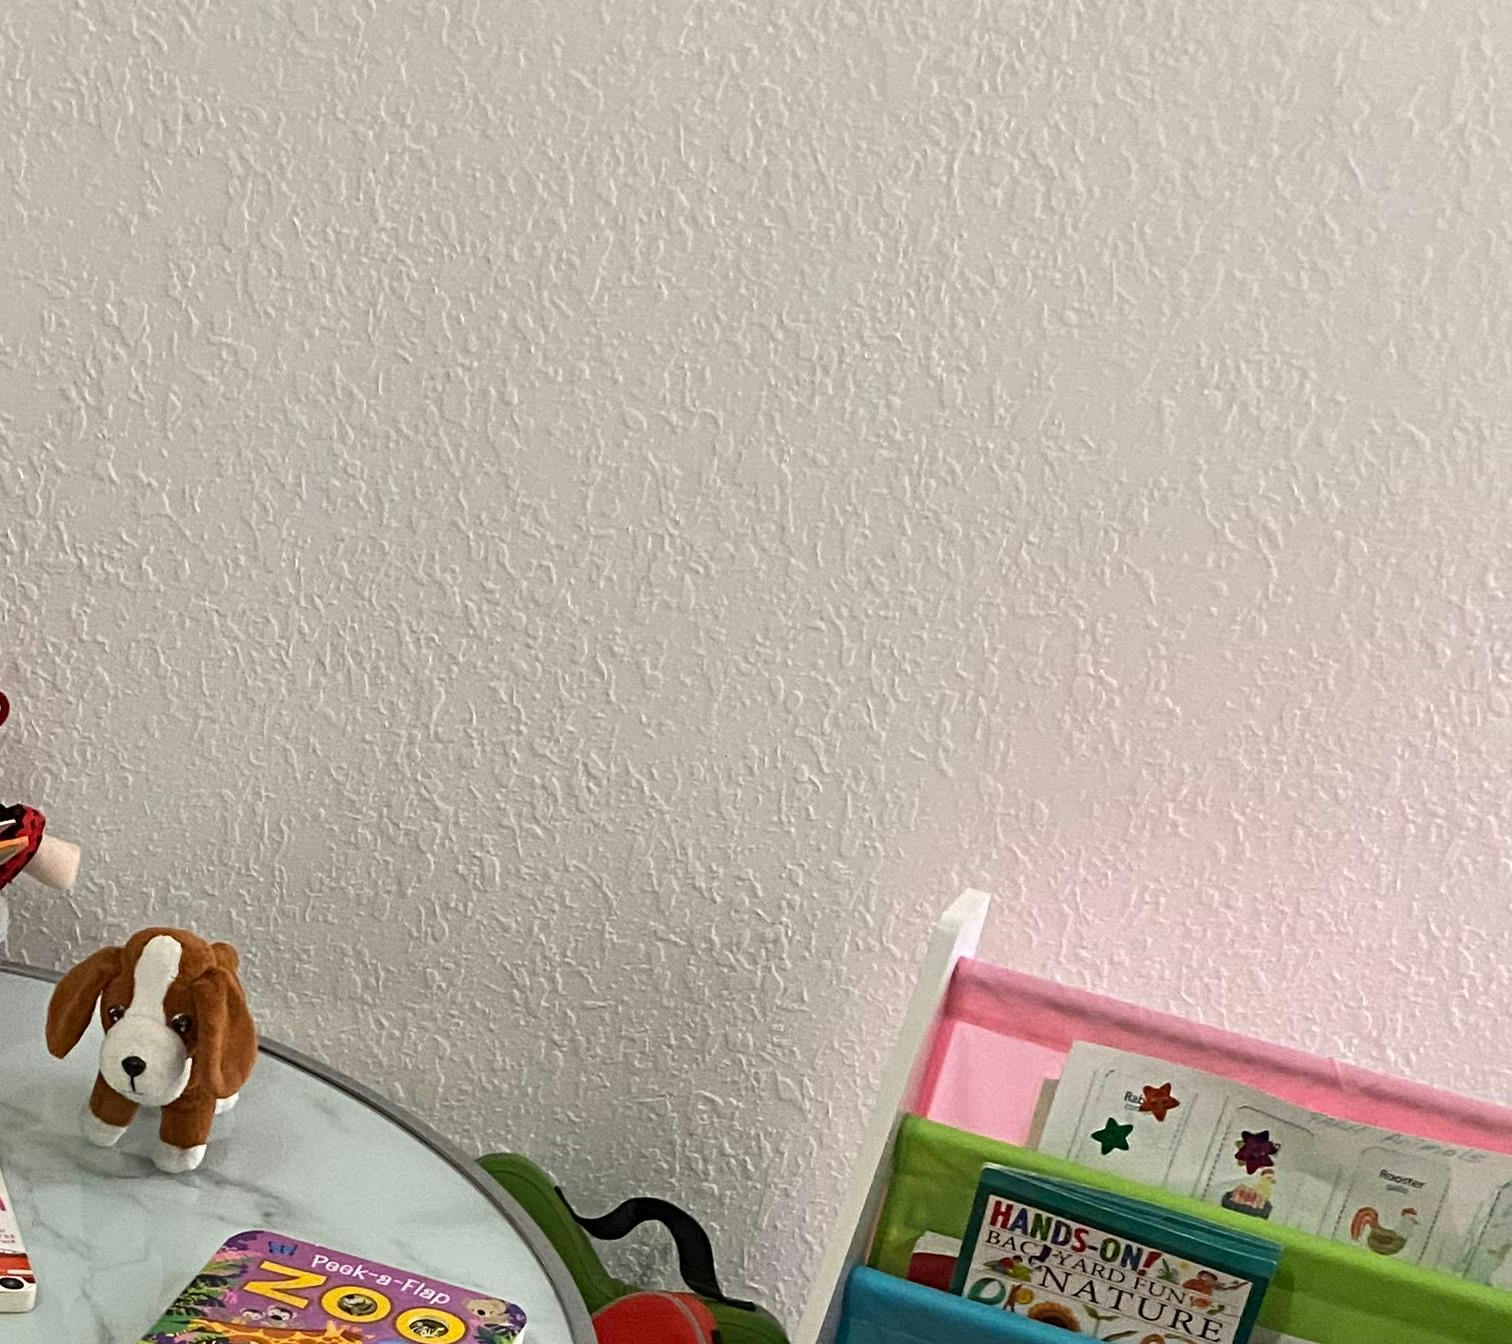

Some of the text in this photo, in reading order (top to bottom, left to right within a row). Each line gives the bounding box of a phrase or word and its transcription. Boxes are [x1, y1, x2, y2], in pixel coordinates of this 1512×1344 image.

[1124, 1091, 1145, 1105] Rab
[990, 1200, 1162, 1276] HANDS-ON!
[311, 1254, 452, 1305] Peek-a-Flap
[1039, 1265, 1224, 1342] NATURE
[1133, 1276, 1186, 1305] FUN
